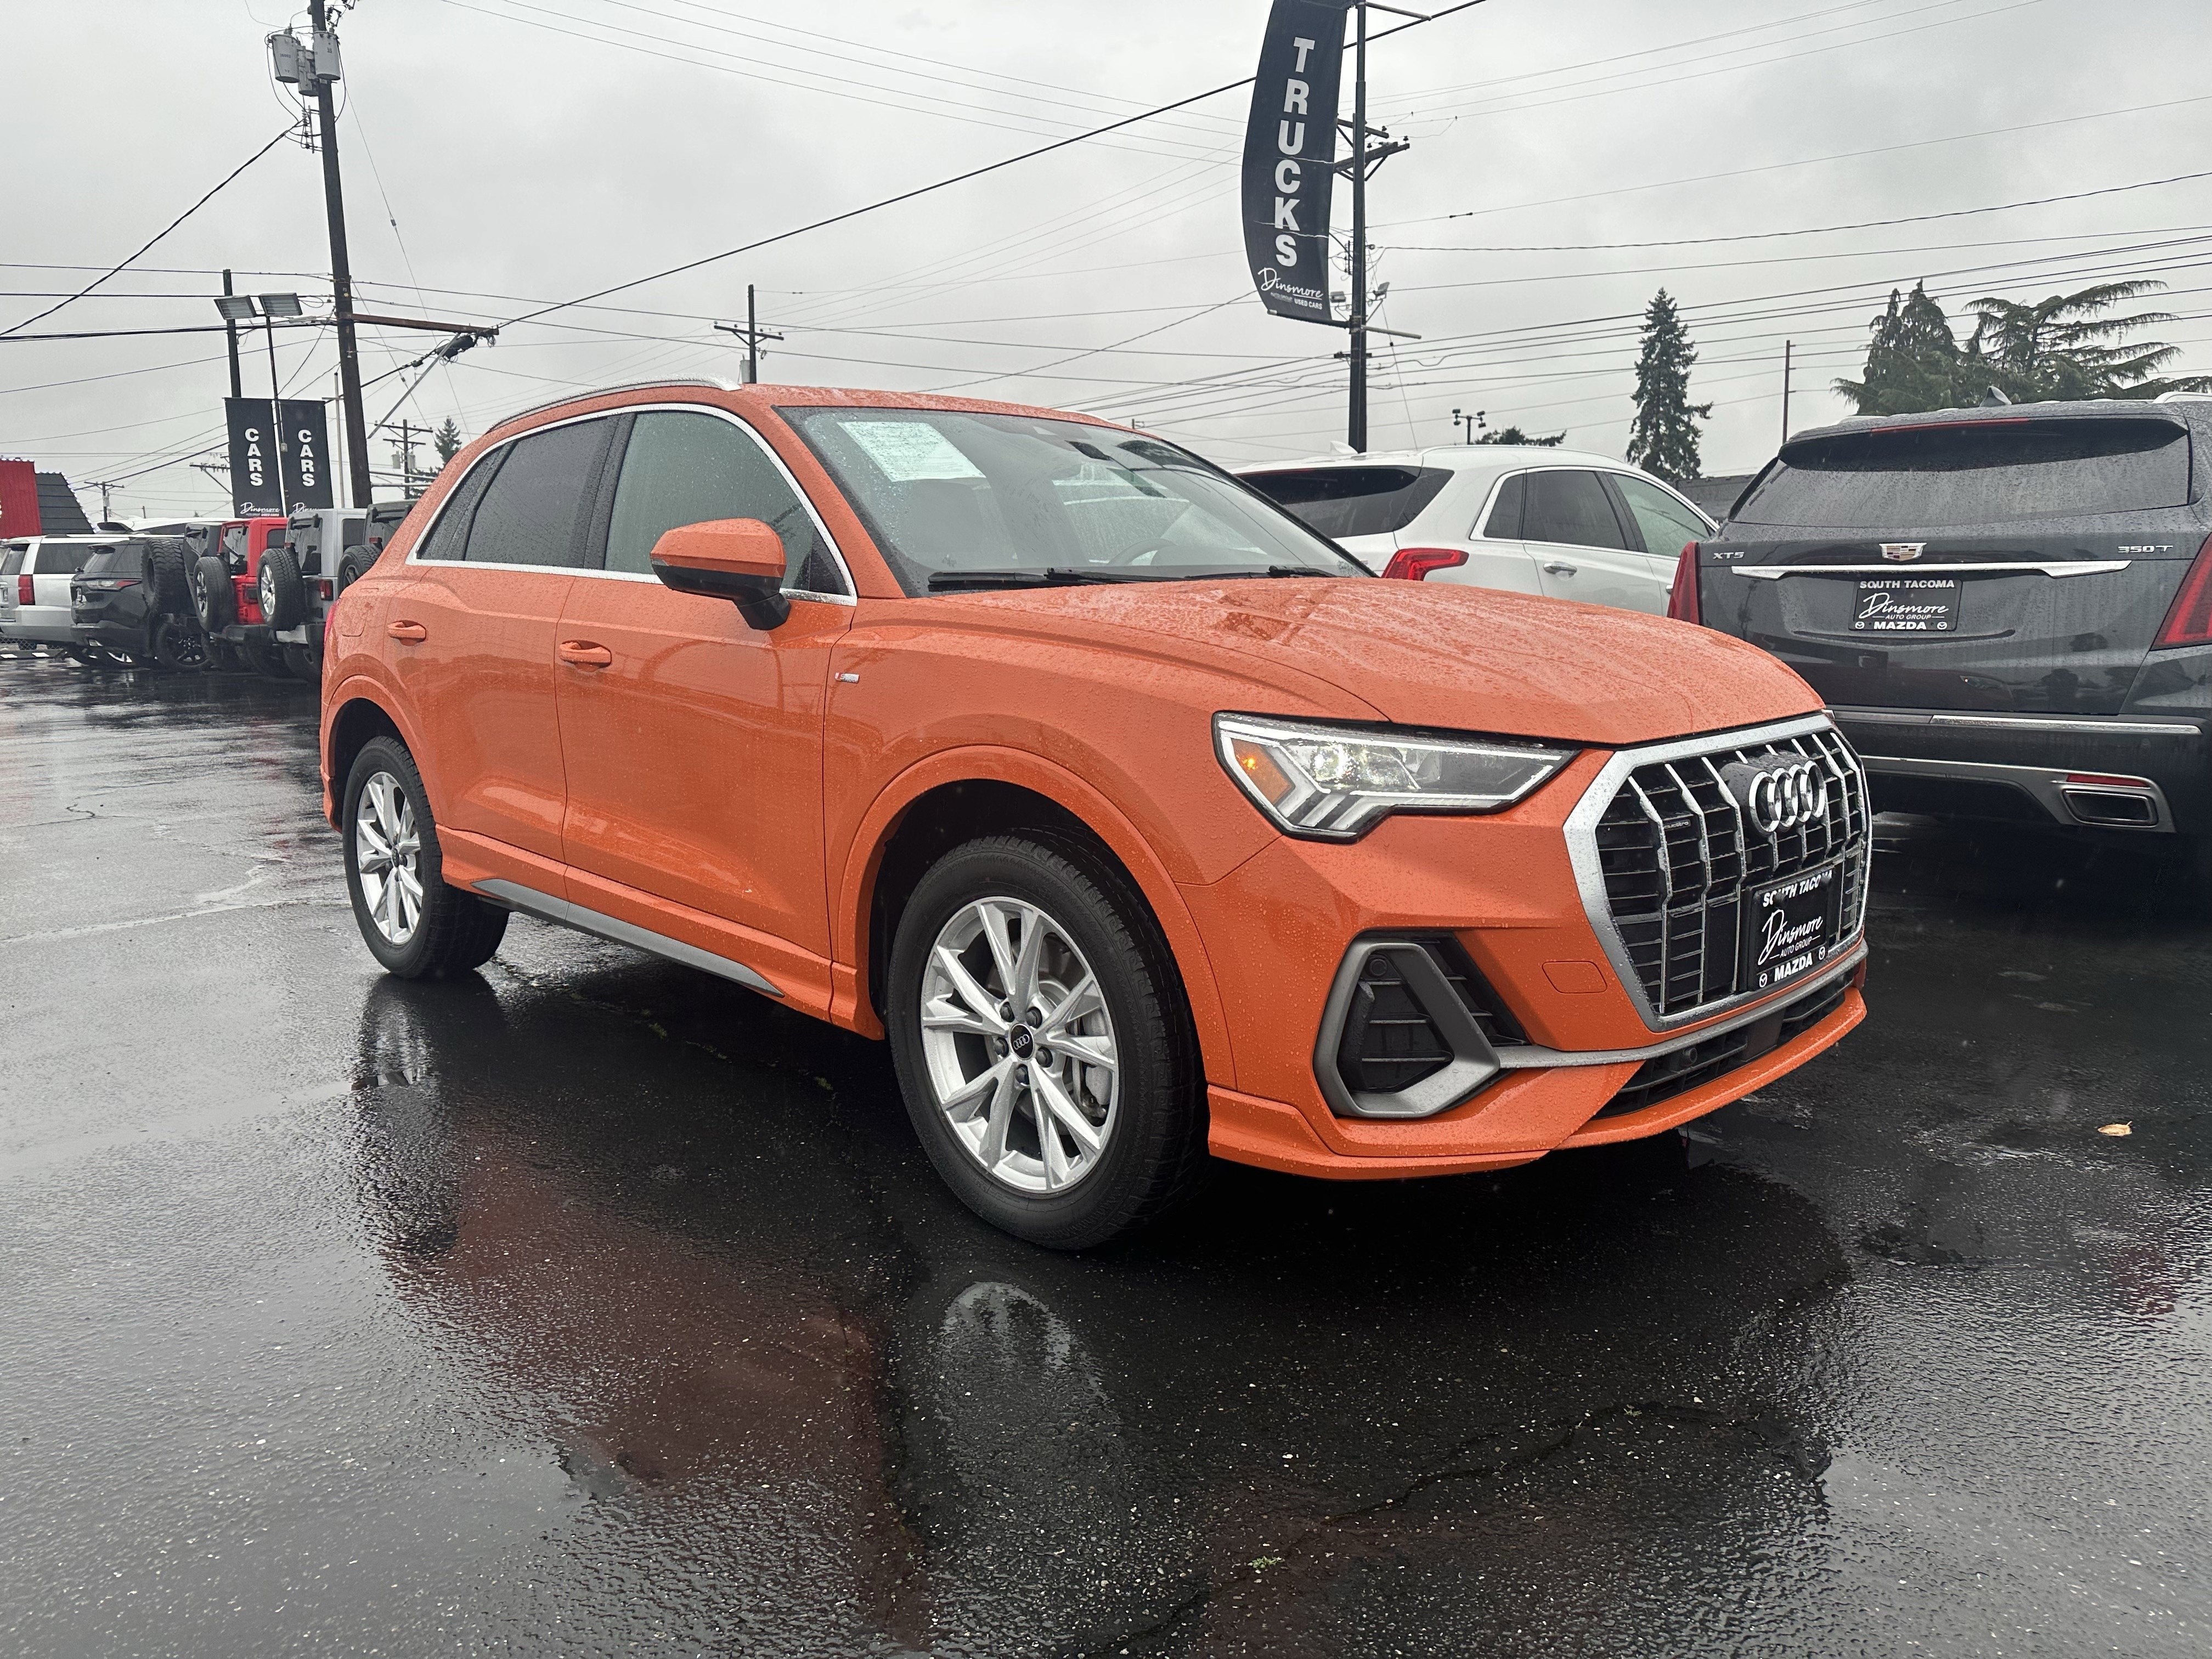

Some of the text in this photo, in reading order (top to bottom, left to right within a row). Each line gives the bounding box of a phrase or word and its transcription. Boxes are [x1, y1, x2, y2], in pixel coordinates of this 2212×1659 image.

[1274, 36, 1315, 267] TRUCKS
[1257, 267, 1324, 298] Dinsmore
[1294, 298, 1323, 310] USED CARS
[245, 428, 263, 486] CARS
[298, 429, 315, 487] CARS
[1860, 580, 1955, 589] SOUTH TACOMA
[1859, 592, 1949, 619] Dinsmore
[1874, 622, 1927, 630] MAZDA
[1758, 909, 1824, 966] Dinsmore
[1780, 936, 1813, 958] AUTO GROUP
[1774, 952, 1813, 982] MAZDA
